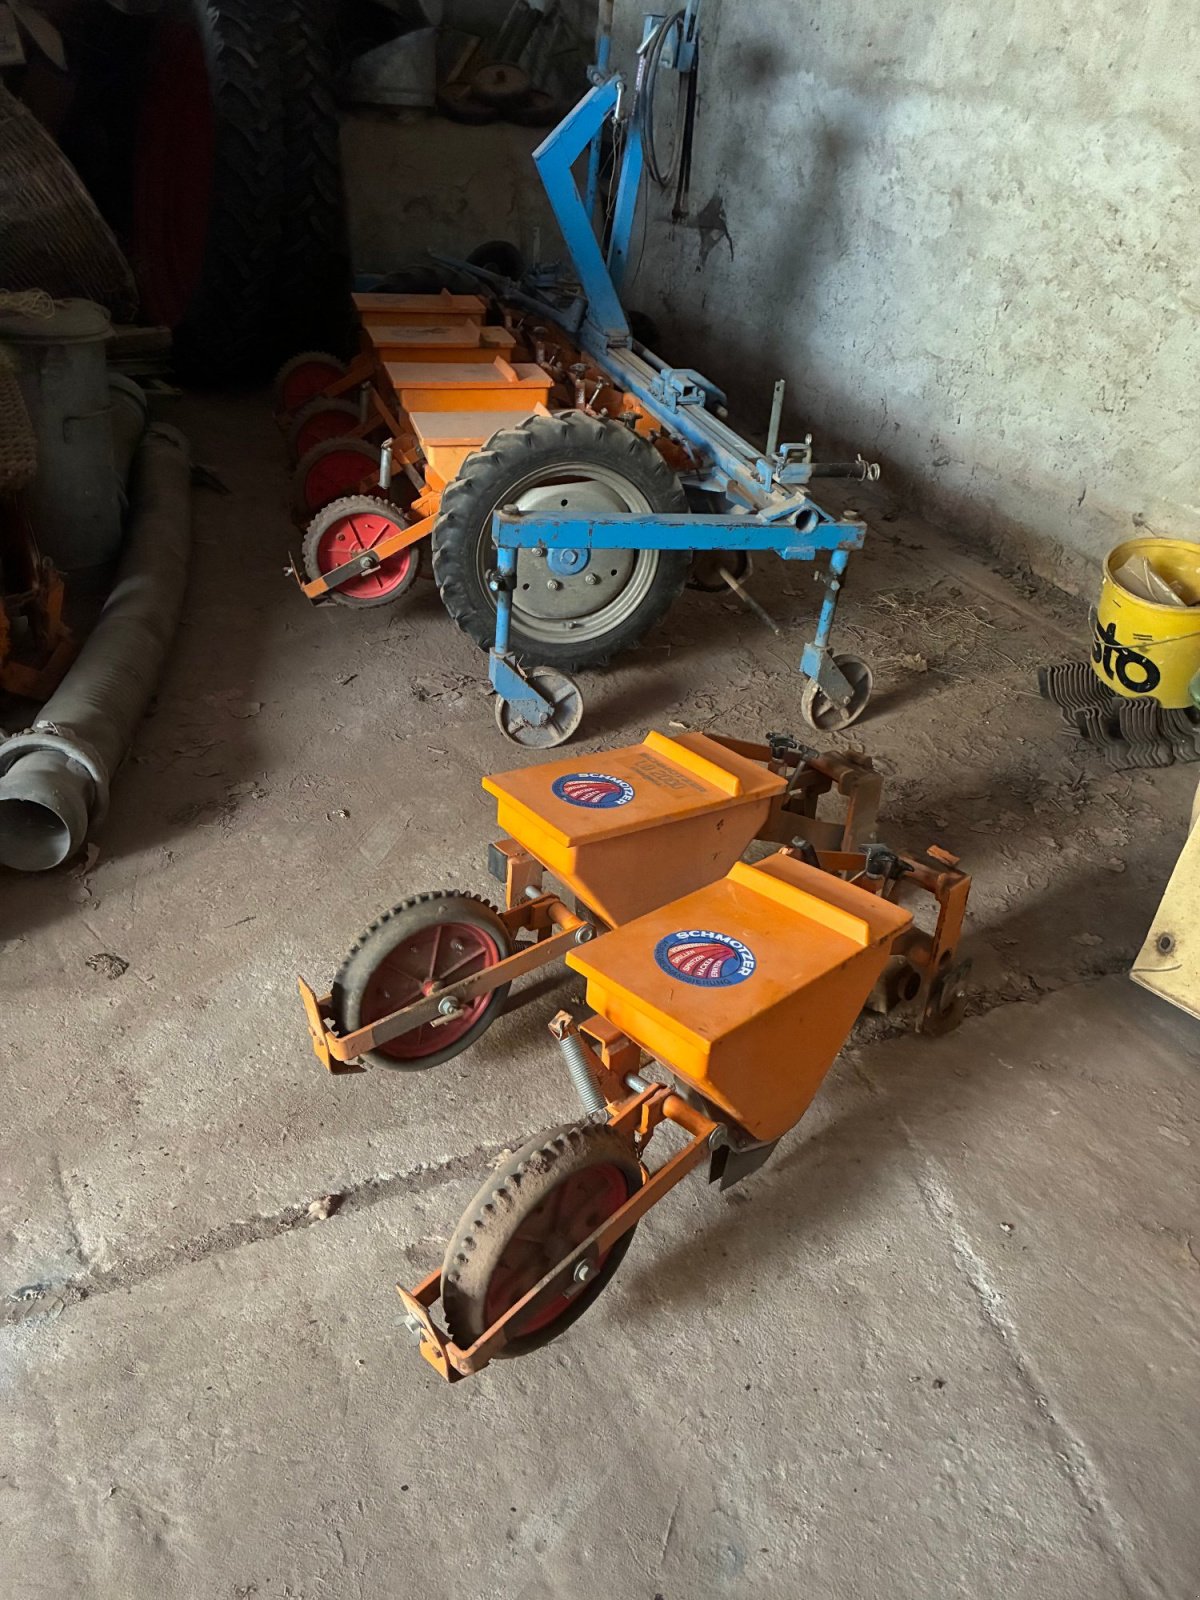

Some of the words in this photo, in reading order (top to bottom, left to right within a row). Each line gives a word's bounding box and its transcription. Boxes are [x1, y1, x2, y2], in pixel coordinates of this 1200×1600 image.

[578, 773, 634, 805] SCHMOTZER
[672, 950, 696, 964] DRILLEN
[676, 930, 755, 976] SCHMOTZER
[696, 957, 715, 976] HACKEN
